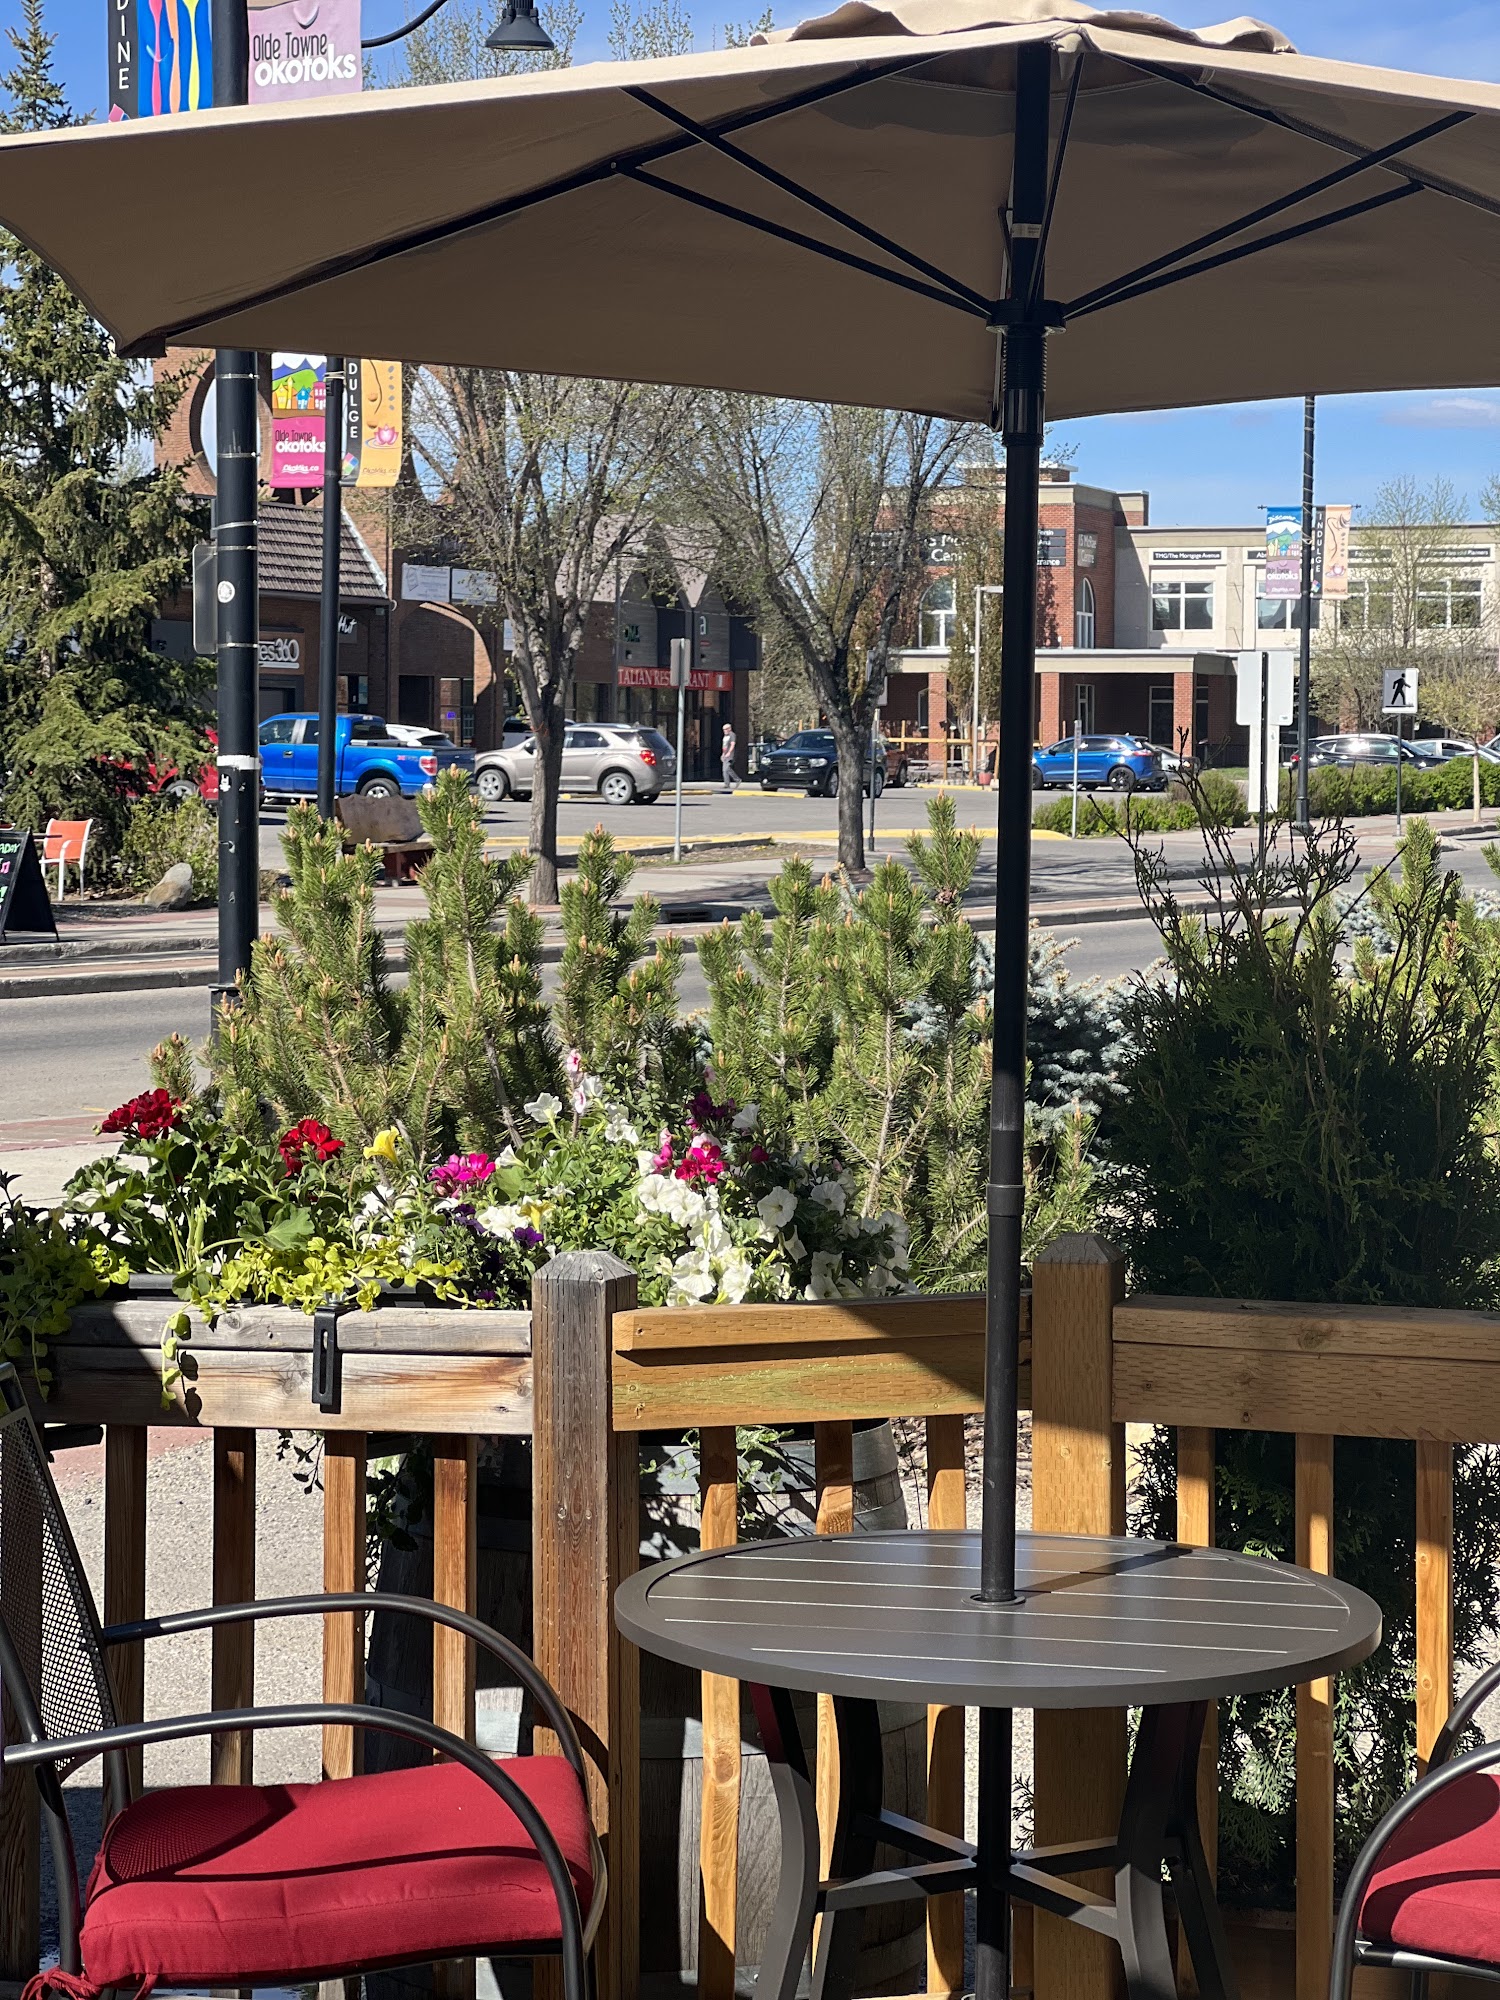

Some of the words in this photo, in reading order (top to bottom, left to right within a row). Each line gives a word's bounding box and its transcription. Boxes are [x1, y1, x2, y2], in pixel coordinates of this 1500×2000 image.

[253, 34, 281, 62] Olde
[285, 31, 328, 58] Towne
[254, 44, 357, 87] okotoks
[348, 362, 360, 439] DULGE
[275, 430, 290, 442] Olde
[291, 430, 313, 442] Towne
[275, 436, 326, 454] okotoks
[1315, 513, 1324, 573] INDULGE
[338, 615, 358, 634] Hut
[259, 638, 300, 663] es360
[618, 668, 652, 685] TALIAN
